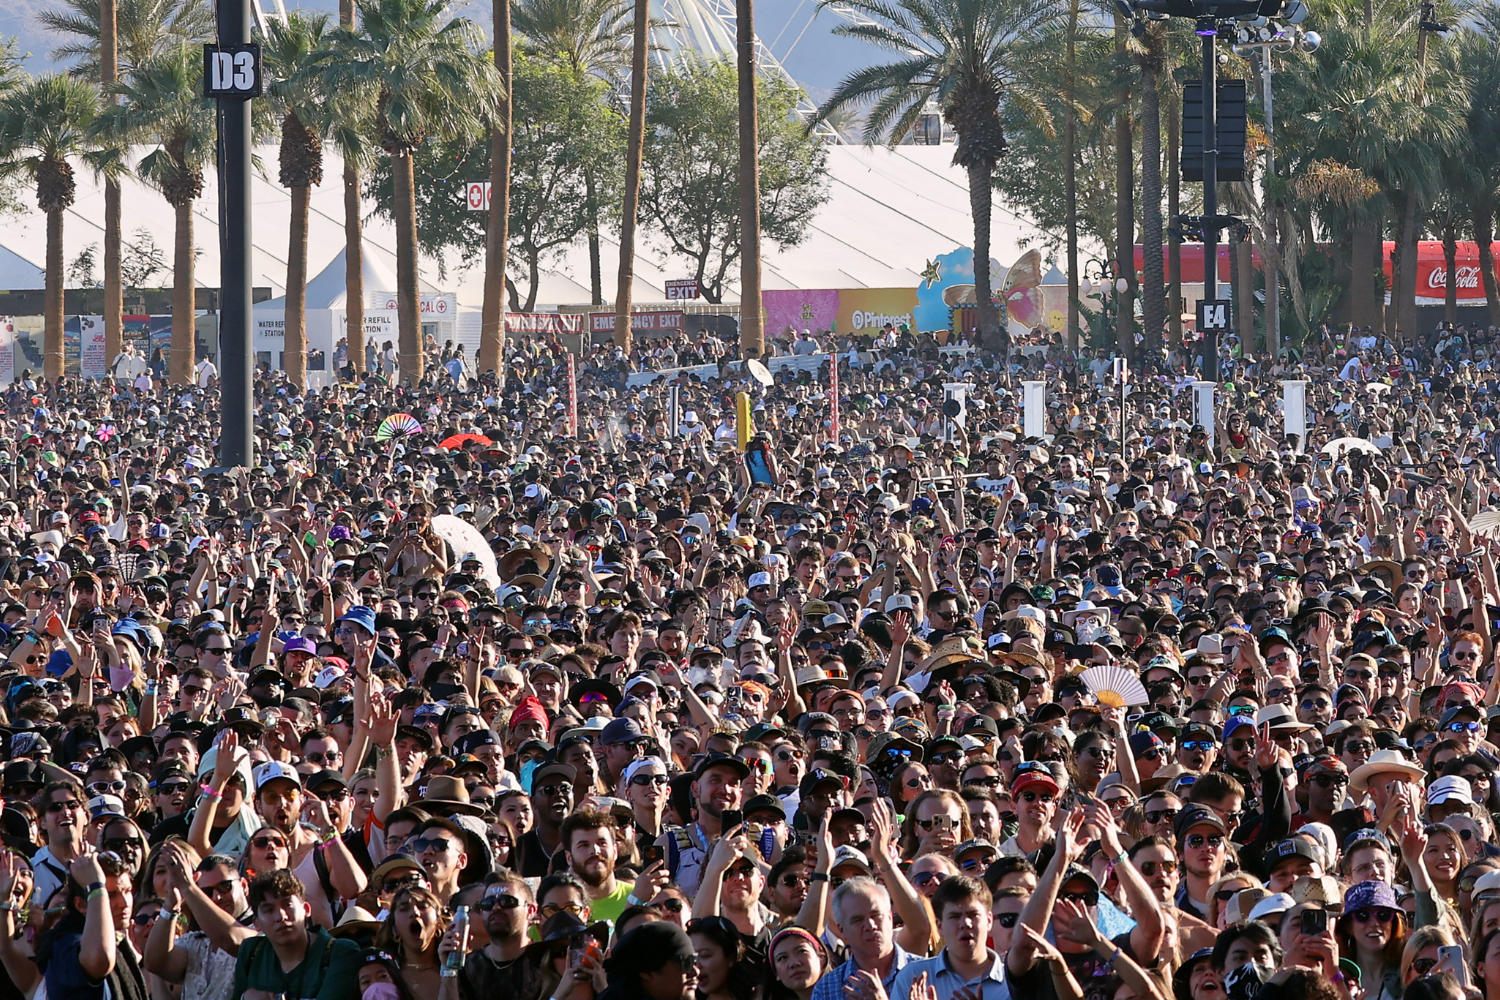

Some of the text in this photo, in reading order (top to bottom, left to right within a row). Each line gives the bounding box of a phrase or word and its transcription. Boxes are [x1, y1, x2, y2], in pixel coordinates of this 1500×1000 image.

[212, 51, 254, 91] D3
[667, 286, 698, 300] EXIT
[593, 314, 682, 330] EMEENCY EXIT
[864, 311, 912, 329] Pinterest
[1204, 305, 1226, 329] E4
[815, 767, 827, 780] LA
